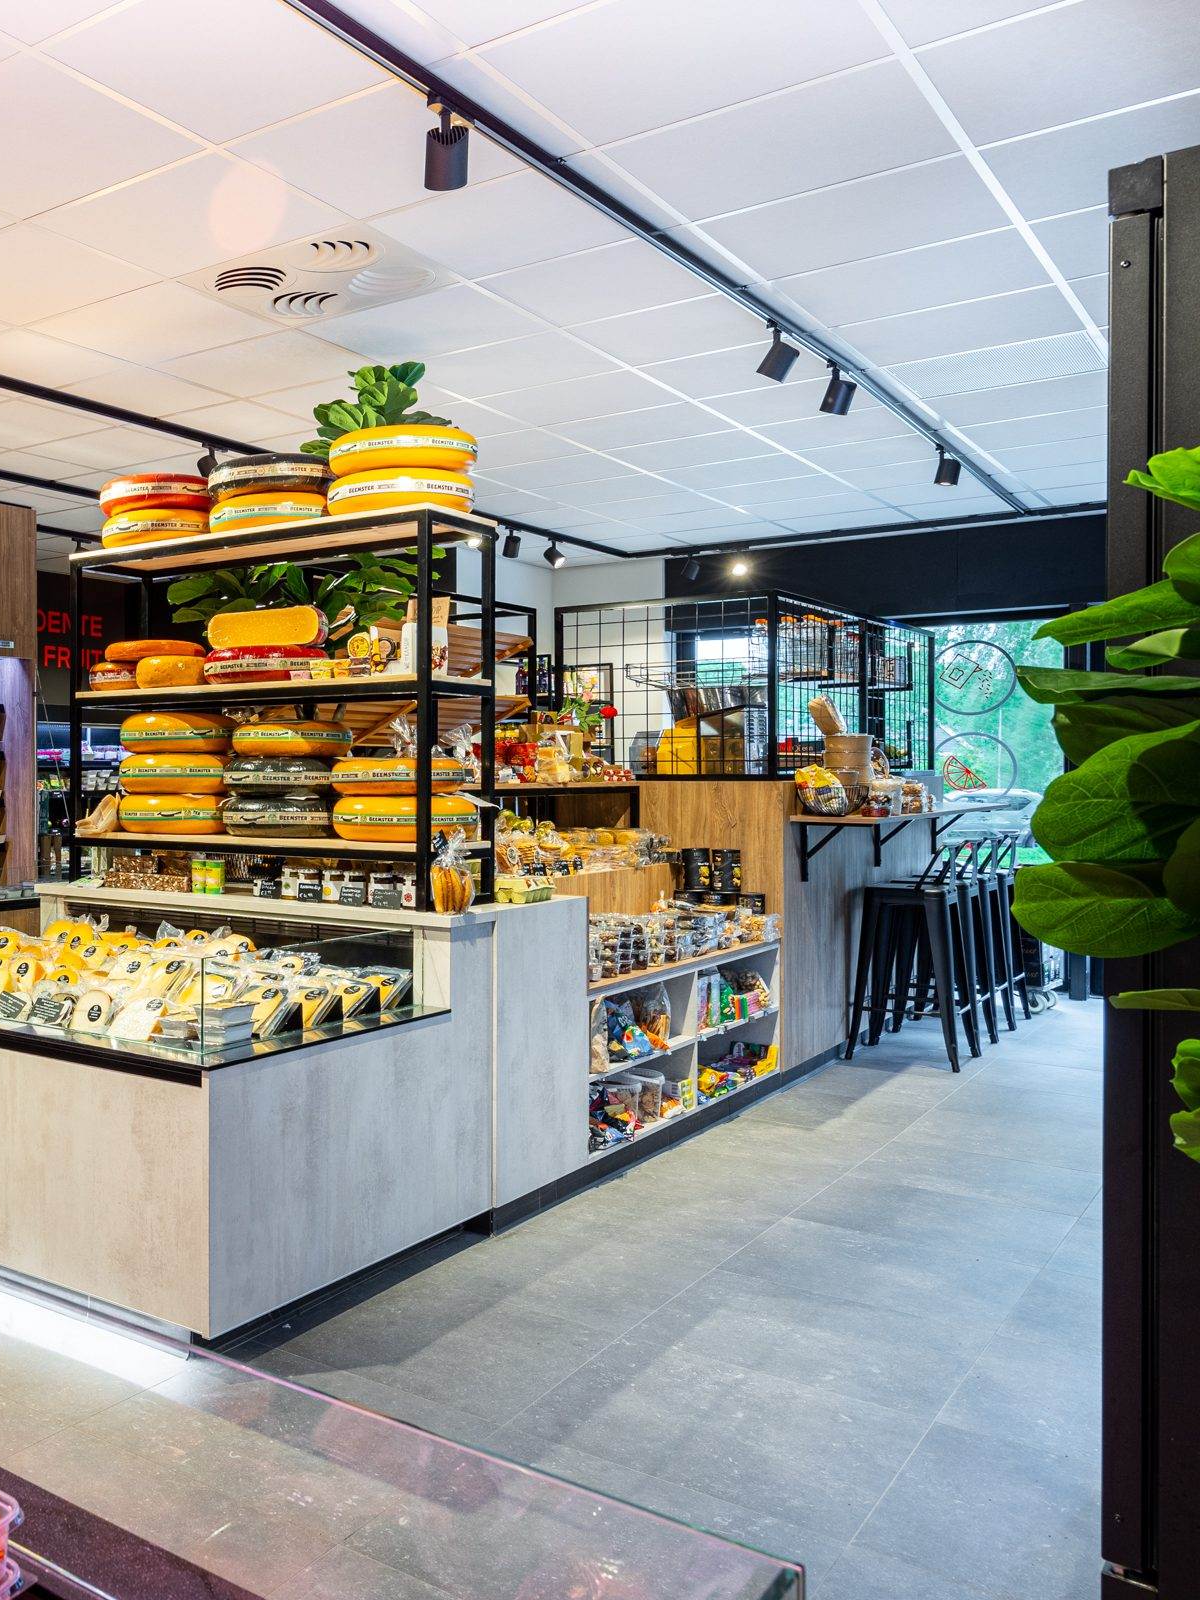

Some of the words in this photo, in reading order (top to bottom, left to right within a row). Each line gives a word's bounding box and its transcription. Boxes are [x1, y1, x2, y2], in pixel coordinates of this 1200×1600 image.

[431, 438, 454, 446] BEEMSTER
[348, 485, 375, 494] BEEMSTER
[426, 483, 453, 491] BEEMSTER
